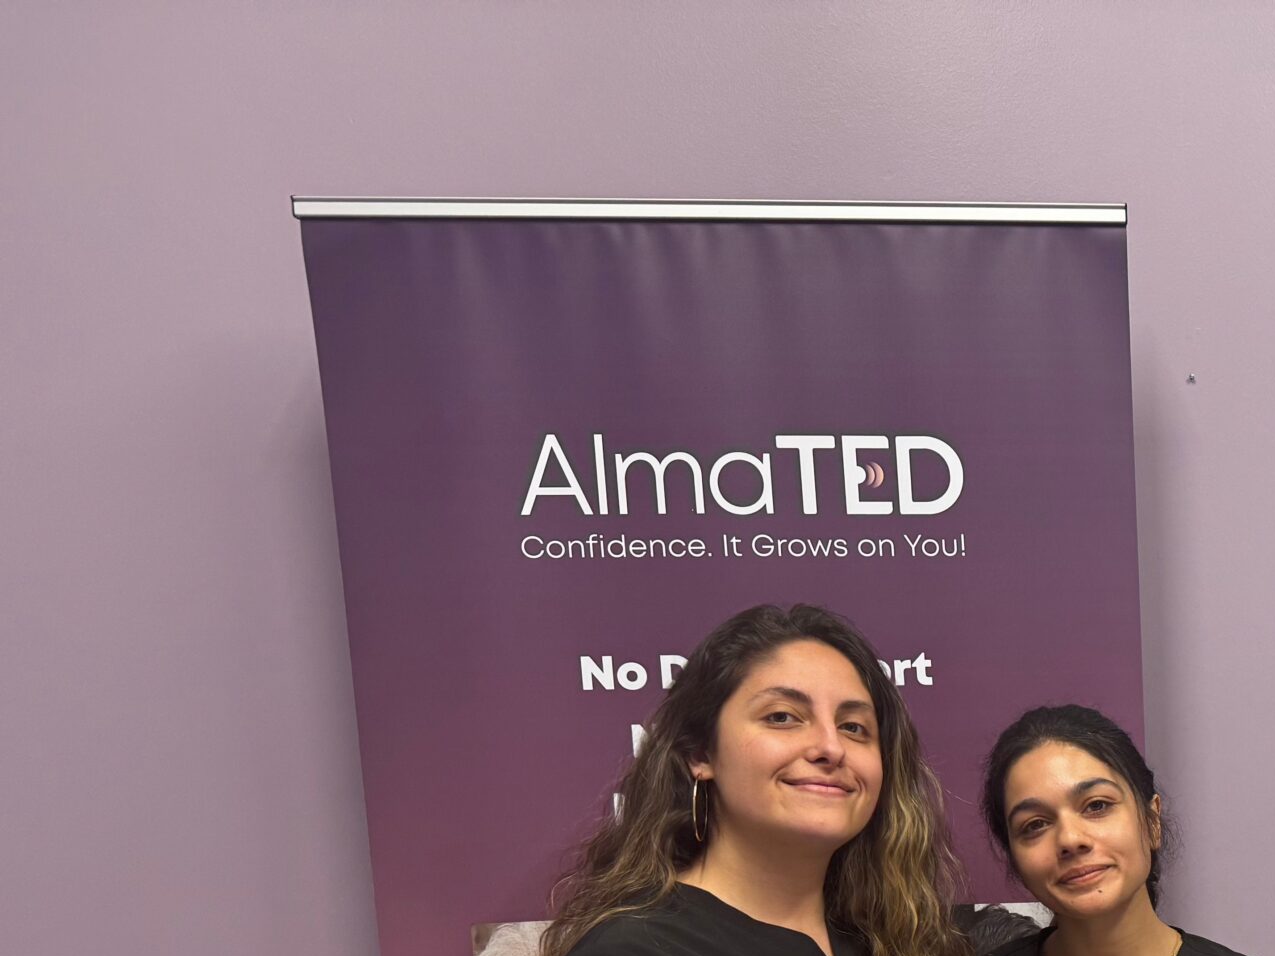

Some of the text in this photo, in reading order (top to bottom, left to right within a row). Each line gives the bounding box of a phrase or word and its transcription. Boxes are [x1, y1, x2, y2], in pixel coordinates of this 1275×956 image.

[520, 433, 965, 516] AlmaTED
[520, 533, 966, 560] Confidence. It Grows on You!
[580, 655, 648, 691] No
